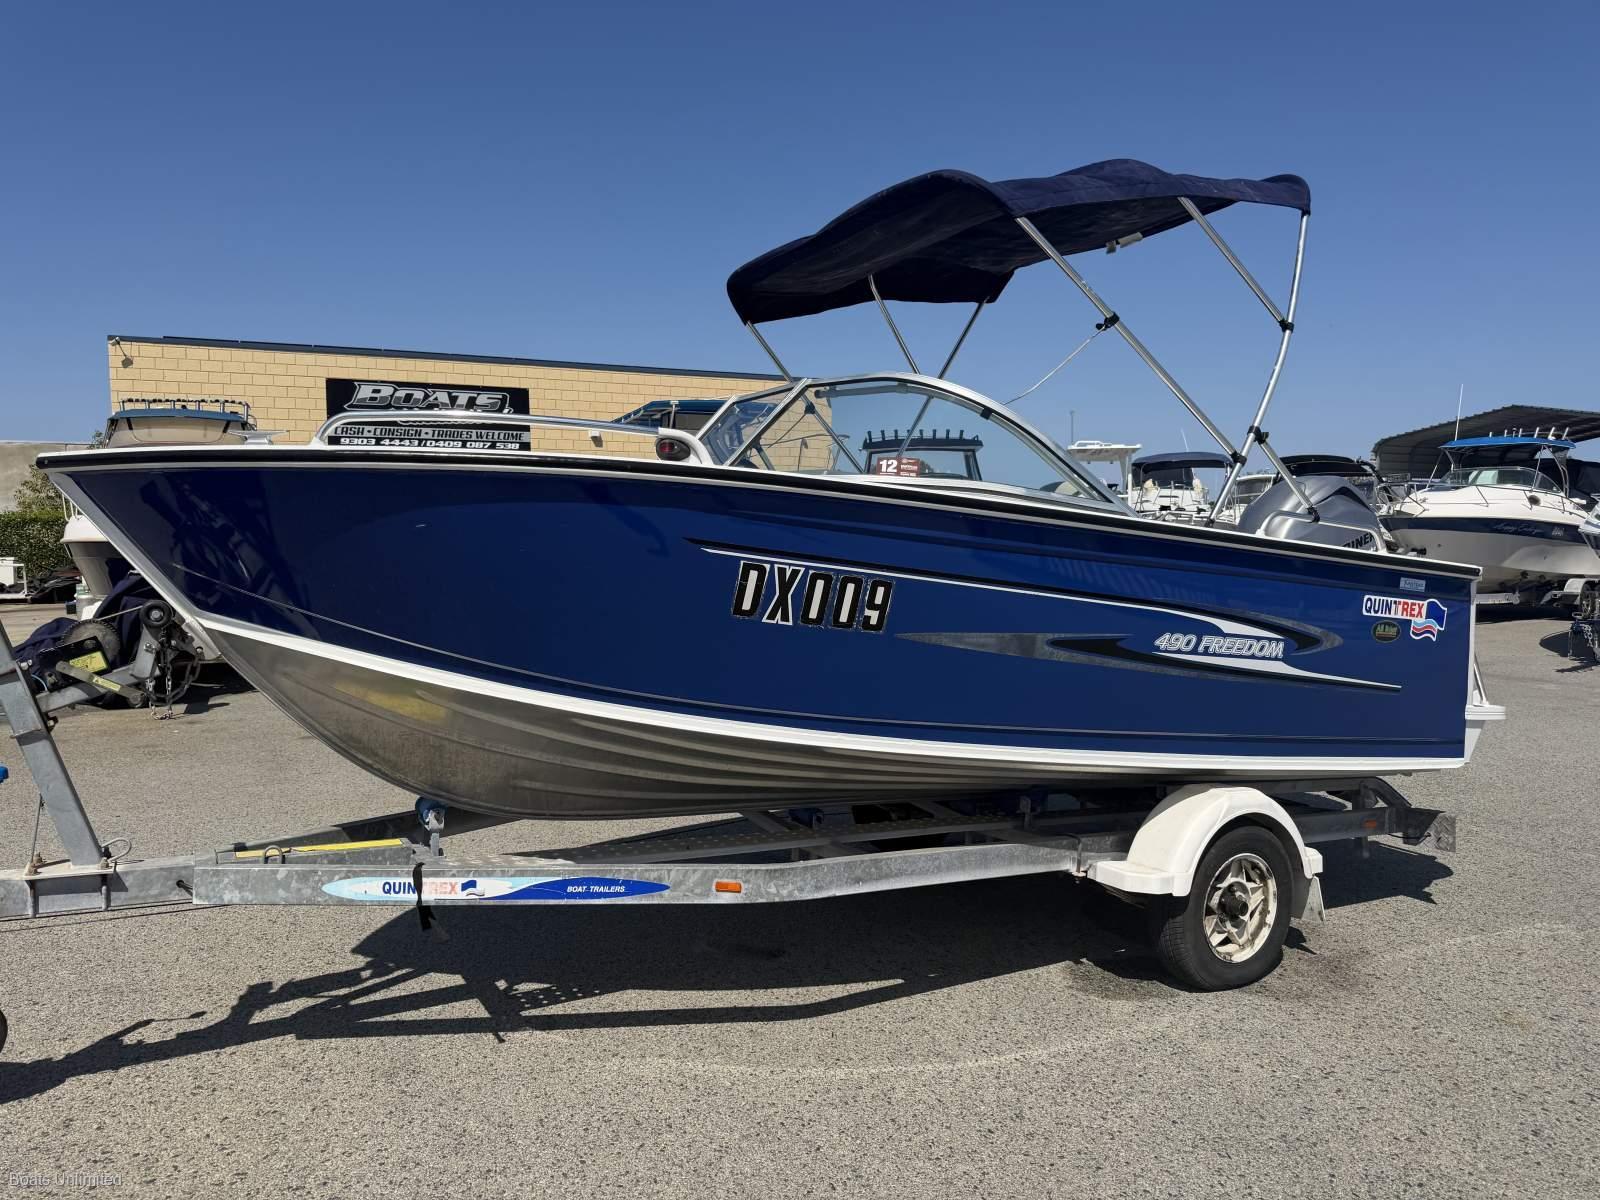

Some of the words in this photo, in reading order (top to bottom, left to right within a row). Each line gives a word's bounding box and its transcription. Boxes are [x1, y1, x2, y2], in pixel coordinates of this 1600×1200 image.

[352, 383, 504, 411] BOATS
[334, 427, 365, 436] CASH
[373, 428, 422, 438] CONSIGN
[431, 430, 472, 439] TRADES
[475, 431, 524, 441] WELCOME
[340, 438, 376, 446] 9303
[880, 459, 898, 473] 12
[732, 561, 895, 633] DX009
[1364, 597, 1425, 619] QUINTREX
[1154, 632, 1198, 652] 490
[1198, 634, 1285, 659] FREEDOM
[382, 881, 458, 895] QUINREX
[566, 885, 587, 893] BOAT
[589, 885, 626, 893] TRAILERS
